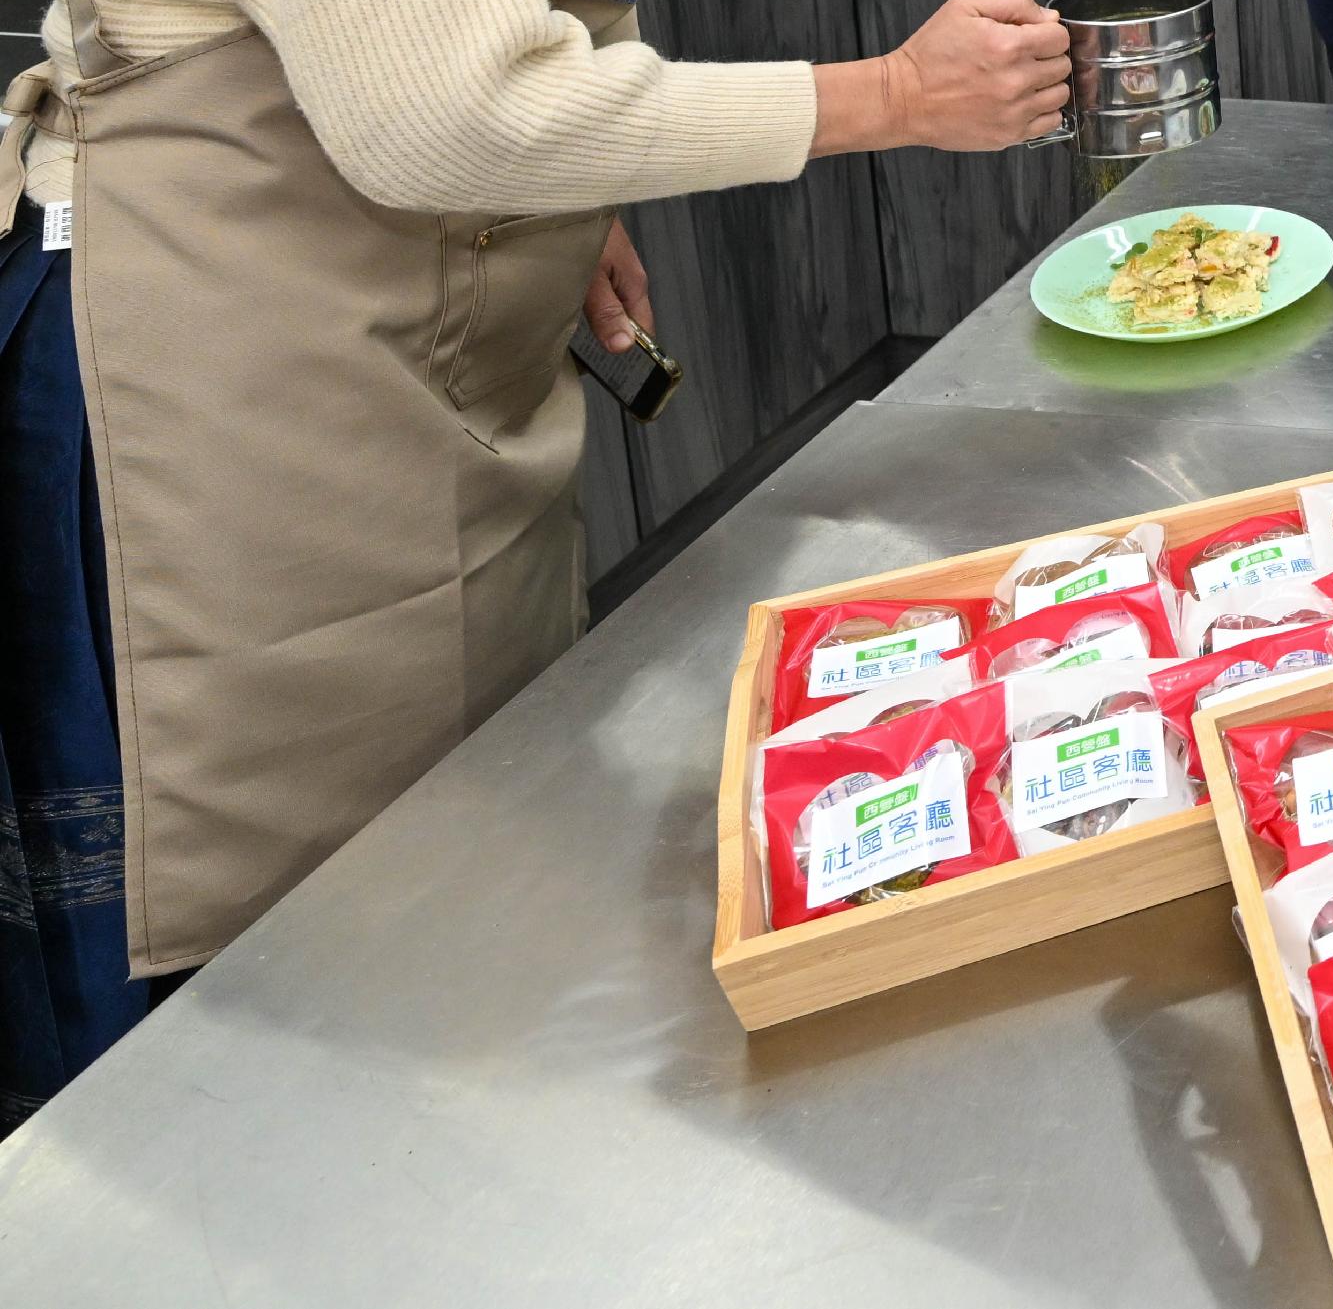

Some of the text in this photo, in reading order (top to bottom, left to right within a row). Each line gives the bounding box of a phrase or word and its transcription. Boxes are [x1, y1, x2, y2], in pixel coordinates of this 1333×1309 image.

[1066, 733, 1111, 758] 西營盤
[1025, 749, 1153, 803] 社區客廳
[822, 799, 954, 875] 社區客廳
